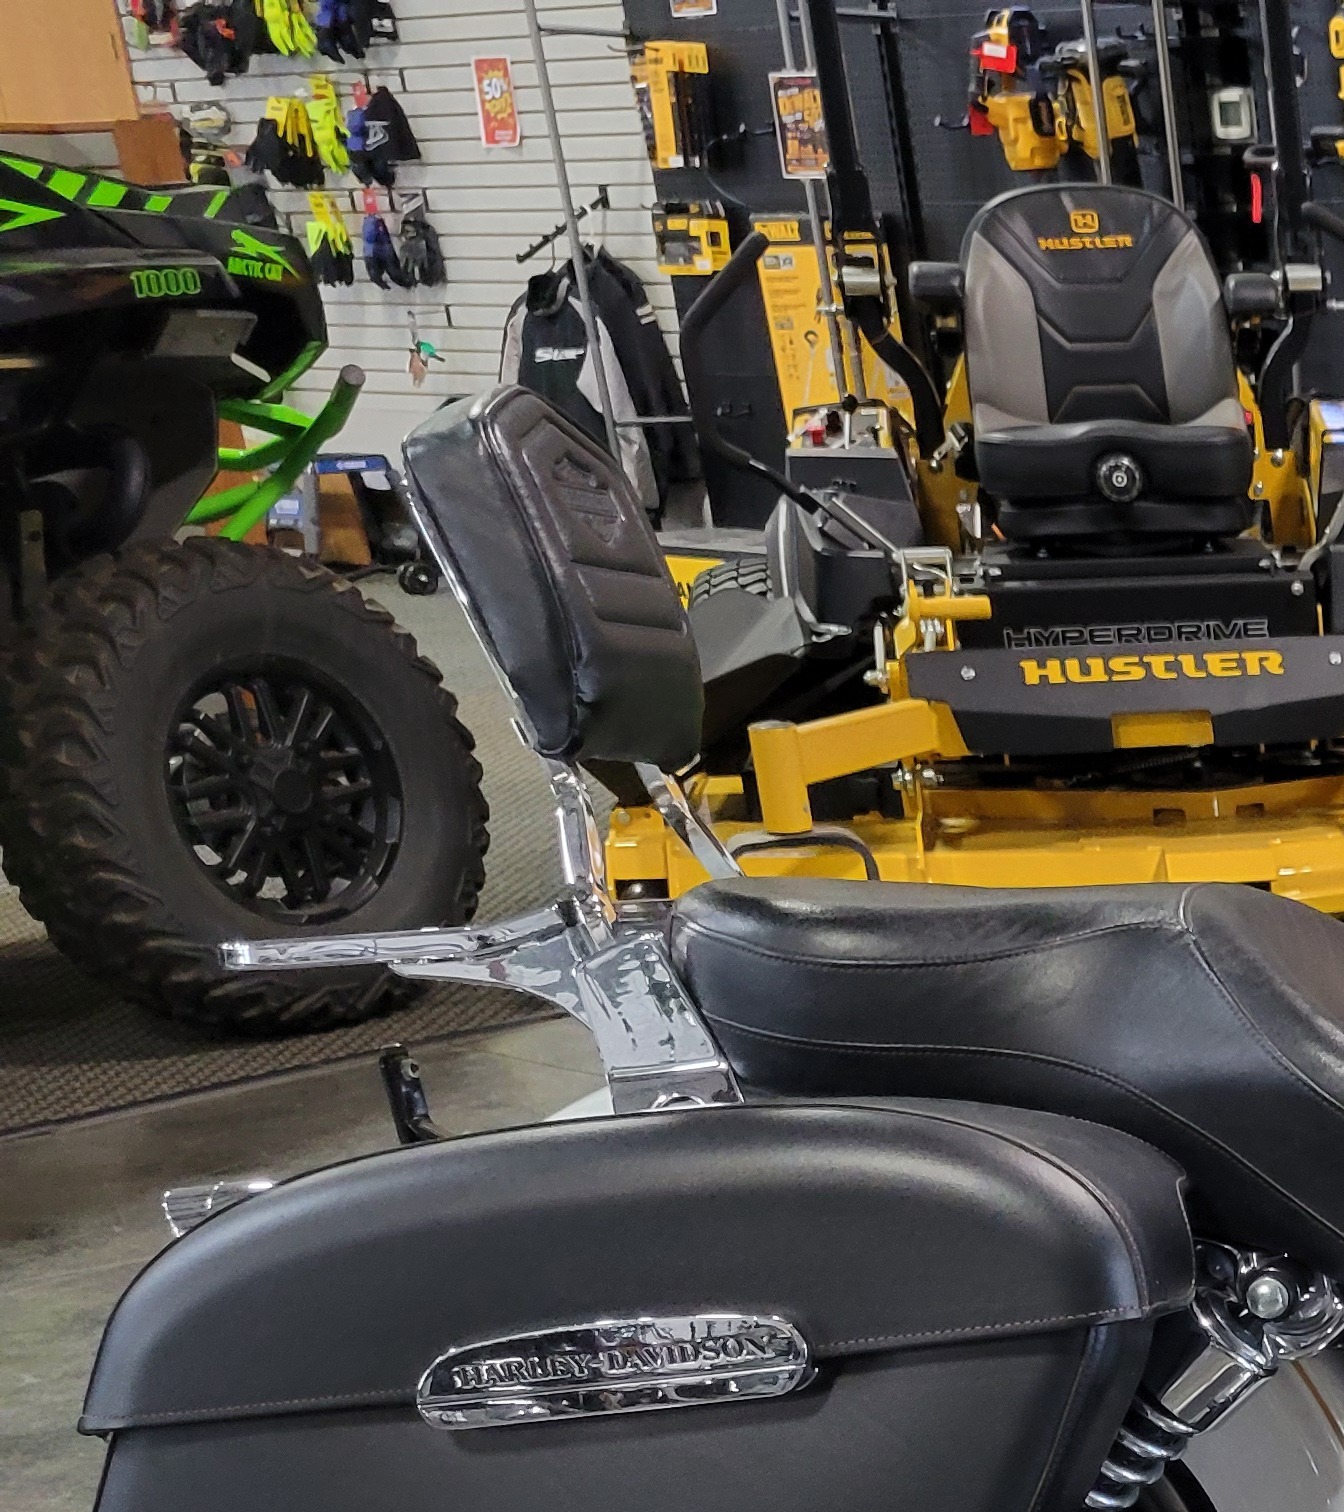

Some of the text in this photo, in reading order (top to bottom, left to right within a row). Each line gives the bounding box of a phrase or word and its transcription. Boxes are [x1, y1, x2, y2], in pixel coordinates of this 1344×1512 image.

[1037, 235, 1134, 250] HUSTLER
[130, 267, 202, 298] 1000
[1003, 619, 1269, 649] HYPERDRIVE
[1019, 650, 1285, 686] HUSTLER
[453, 1336, 775, 1389] HARLEY-DAVIDSON
